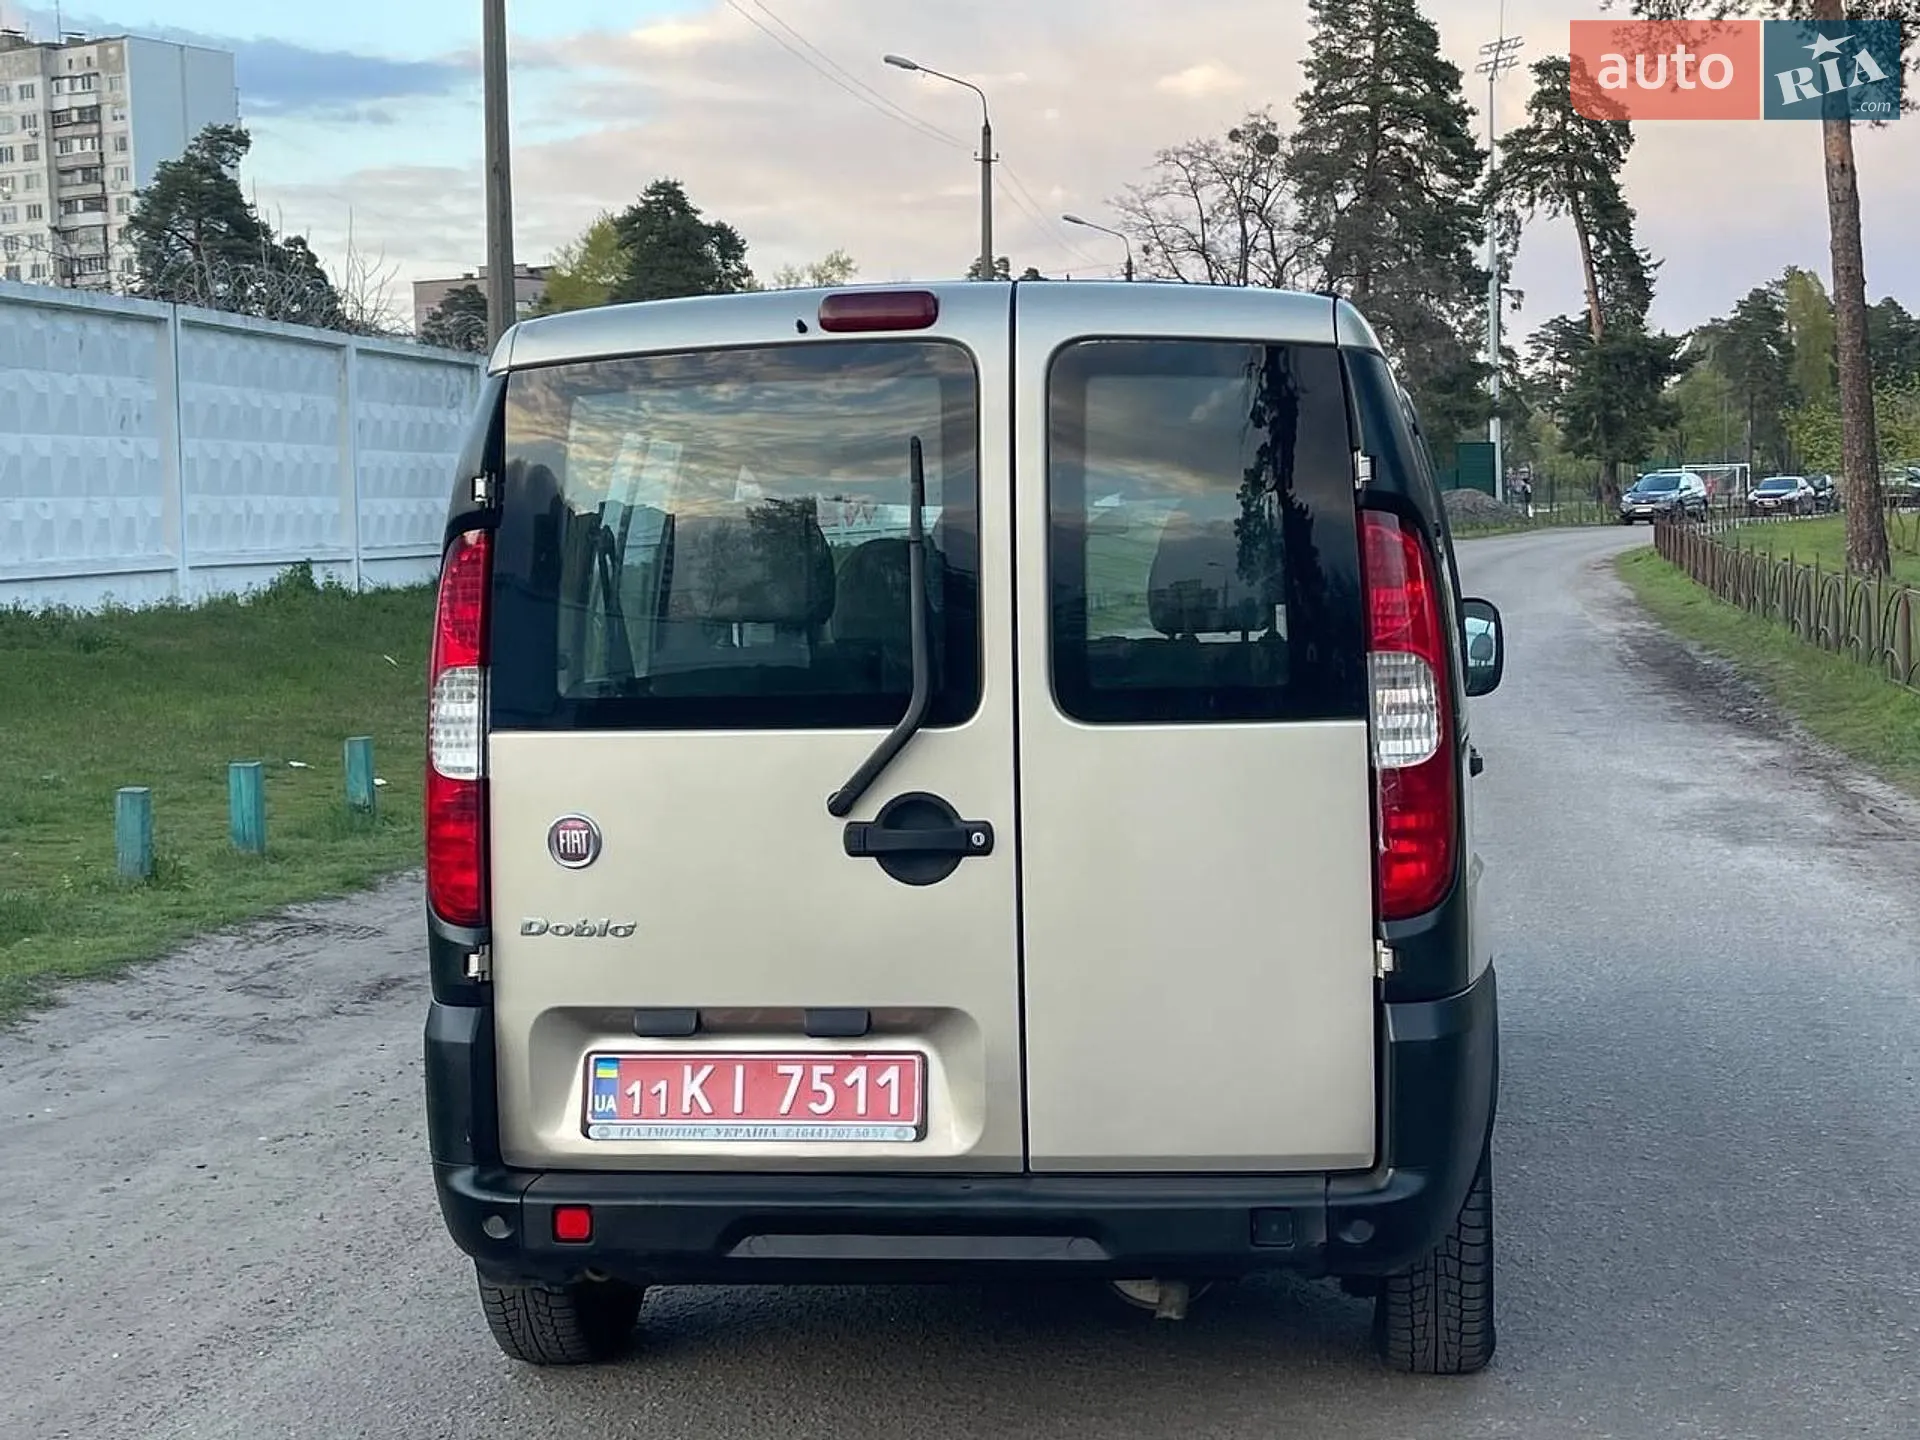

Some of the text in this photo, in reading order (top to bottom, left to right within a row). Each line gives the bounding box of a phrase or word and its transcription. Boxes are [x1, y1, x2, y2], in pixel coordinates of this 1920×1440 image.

[558, 829, 589, 854] FIAT
[777, 1065, 900, 1116] 7511
[594, 1095, 617, 1113] UA
